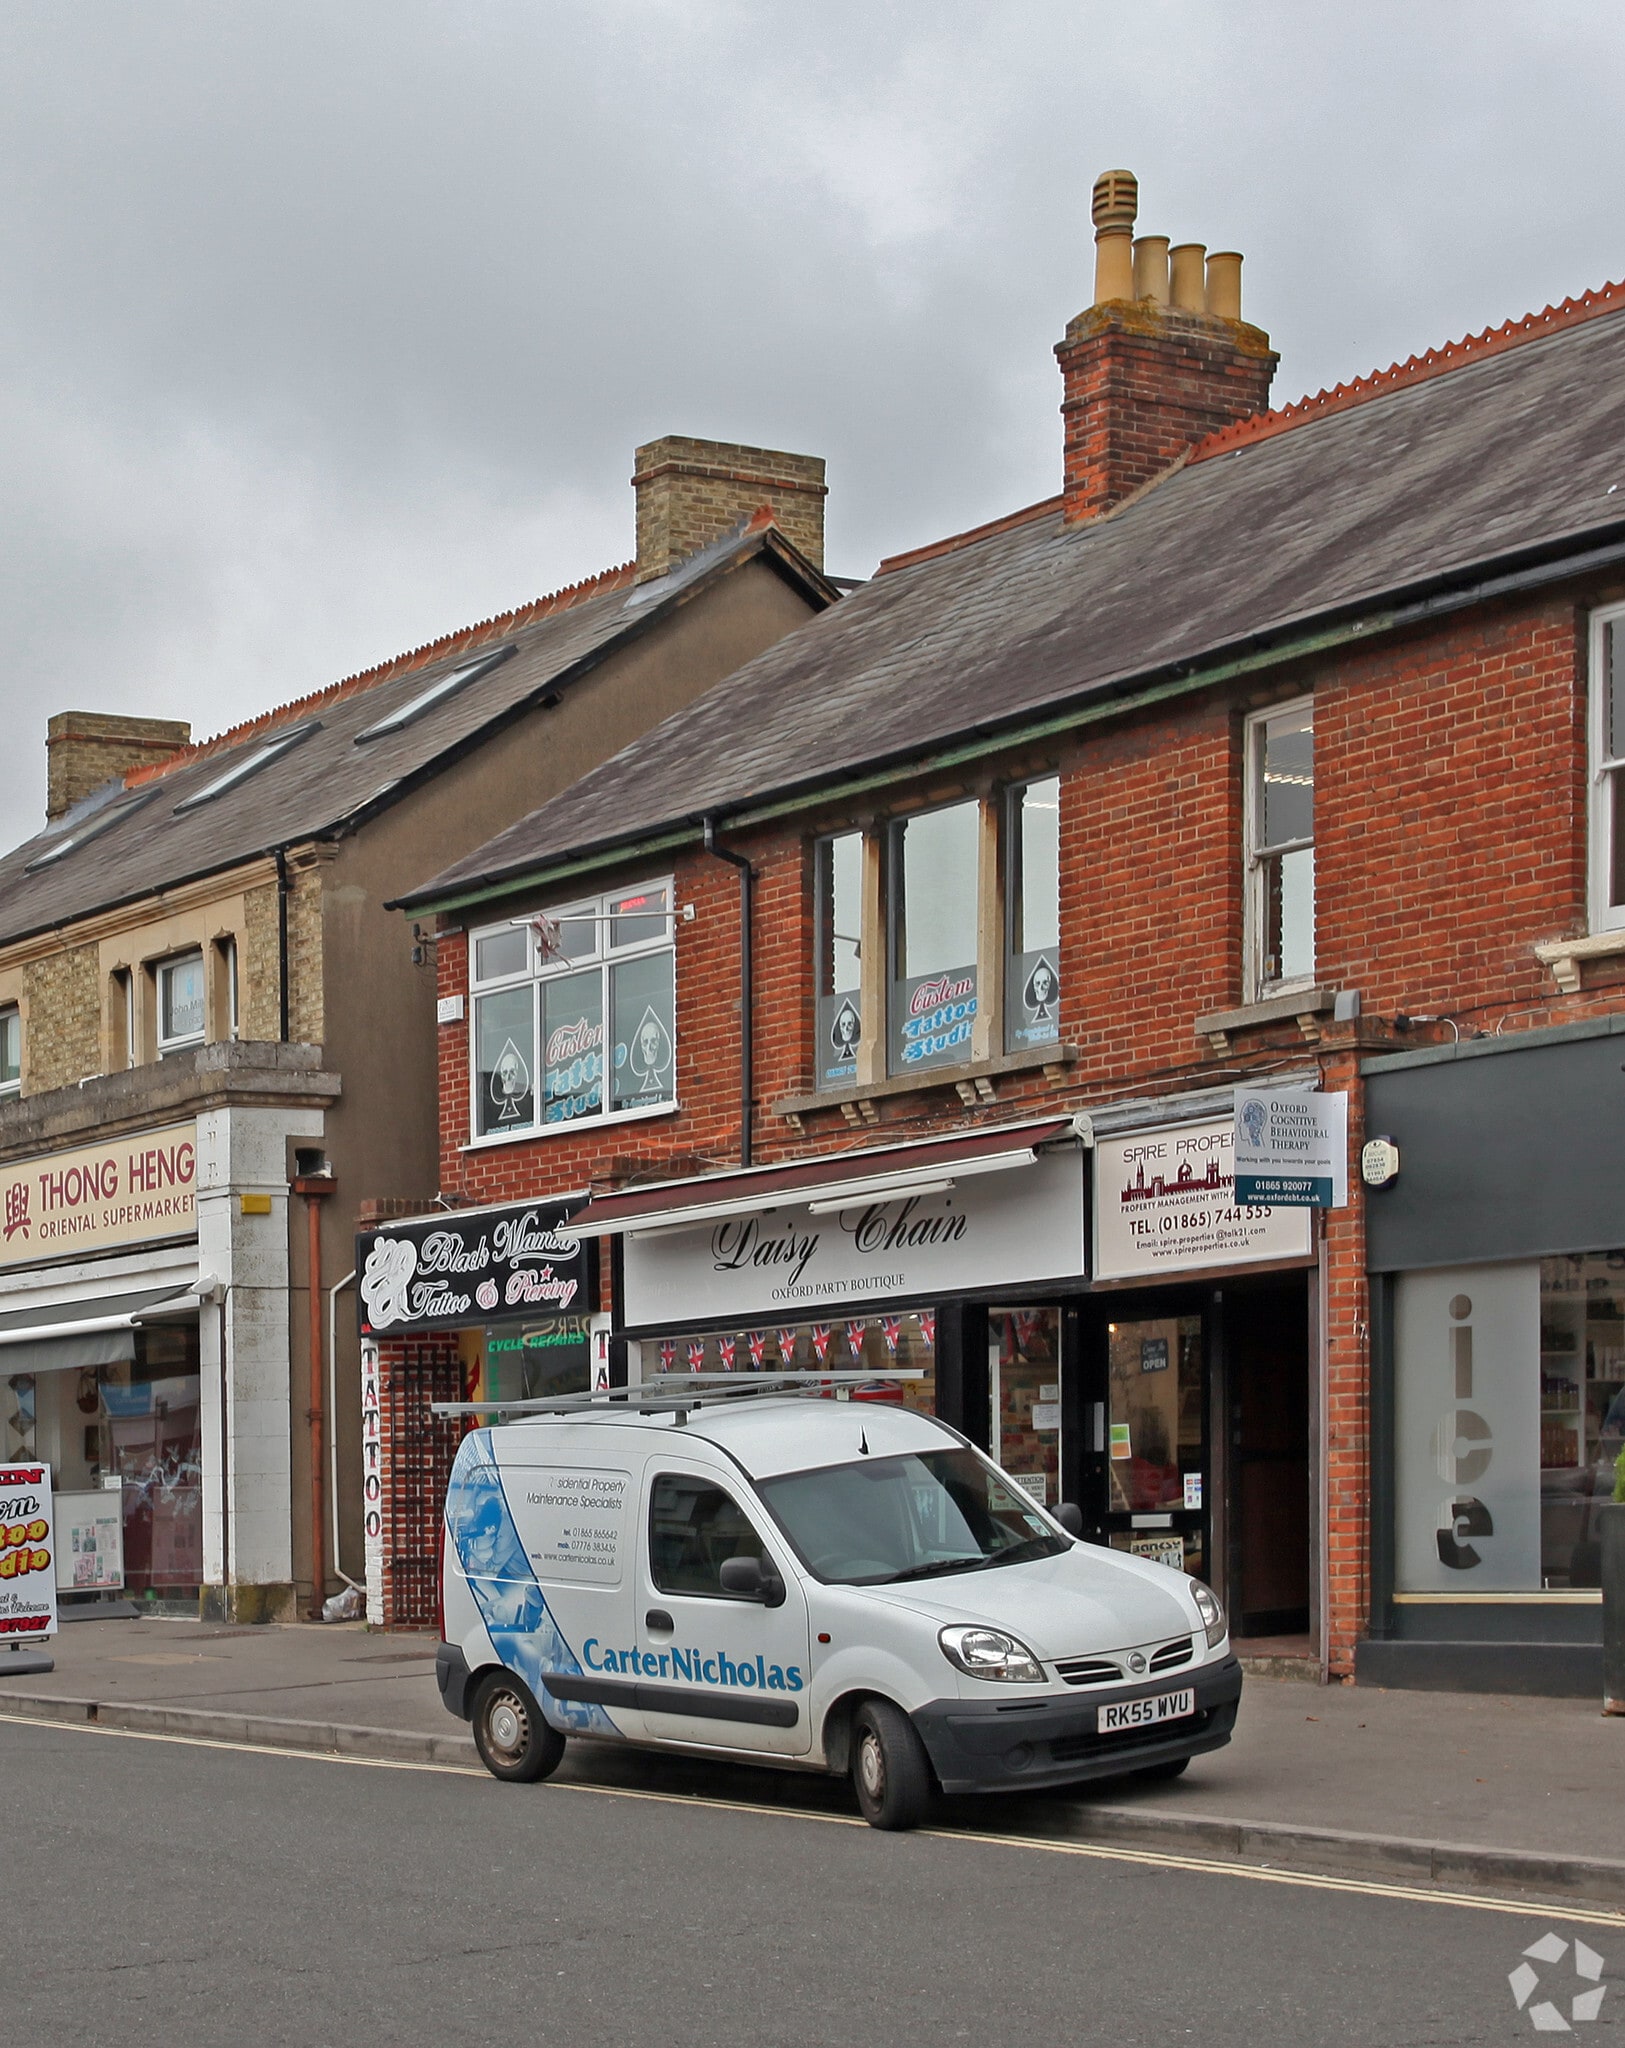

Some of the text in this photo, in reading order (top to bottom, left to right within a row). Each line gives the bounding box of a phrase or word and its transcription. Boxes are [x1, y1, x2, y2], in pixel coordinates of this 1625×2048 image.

[910, 974, 974, 1015] Custom
[902, 997, 978, 1038] Tattoo
[1270, 1101, 1308, 1113] OXFORD
[1270, 1114, 1318, 1126] COGNITIVE
[1270, 1126, 1330, 1139] BEHAVIOURAL
[1123, 1143, 1167, 1163] SPIRE
[1270, 1139, 1310, 1150] THERAPY
[1236, 1156, 1258, 1164] Working
[1317, 1158, 1331, 1166] goals
[39, 1142, 195, 1212] THONG HENG
[1255, 1180, 1312, 1191] 01865 920077
[1121, 1201, 1156, 1213] PROPERTY
[1157, 1194, 1209, 1208] MANAGEMENT
[1210, 1191, 1229, 1201] WITH
[40, 1193, 195, 1239] ORIENTAL SUPERMARKET
[1129, 1205, 1272, 1236] TEL. (01865) 744 555
[711, 1195, 968, 1286] Daisy Chain
[1136, 1239, 1158, 1250] Email:
[1152, 1238, 1250, 1258] www.spireproperties.co.uk
[417, 1231, 490, 1276] Black
[410, 1269, 578, 1319] Tattoo & Piercing
[771, 1273, 905, 1300] OXFORD PARTY BOUTIQUE
[488, 1331, 586, 1353] CYCLE REPAIRS
[1142, 1358, 1167, 1370] OPEN
[362, 1347, 381, 1538] TATTOO
[591, 1478, 626, 1494] Property
[526, 1492, 622, 1509] Maintenance Specialists
[572, 1527, 592, 1538] 01865
[571, 1540, 591, 1551] 07776
[583, 1638, 804, 1692] CarterNicholas
[1106, 1692, 1188, 1728] RK55 WVU
